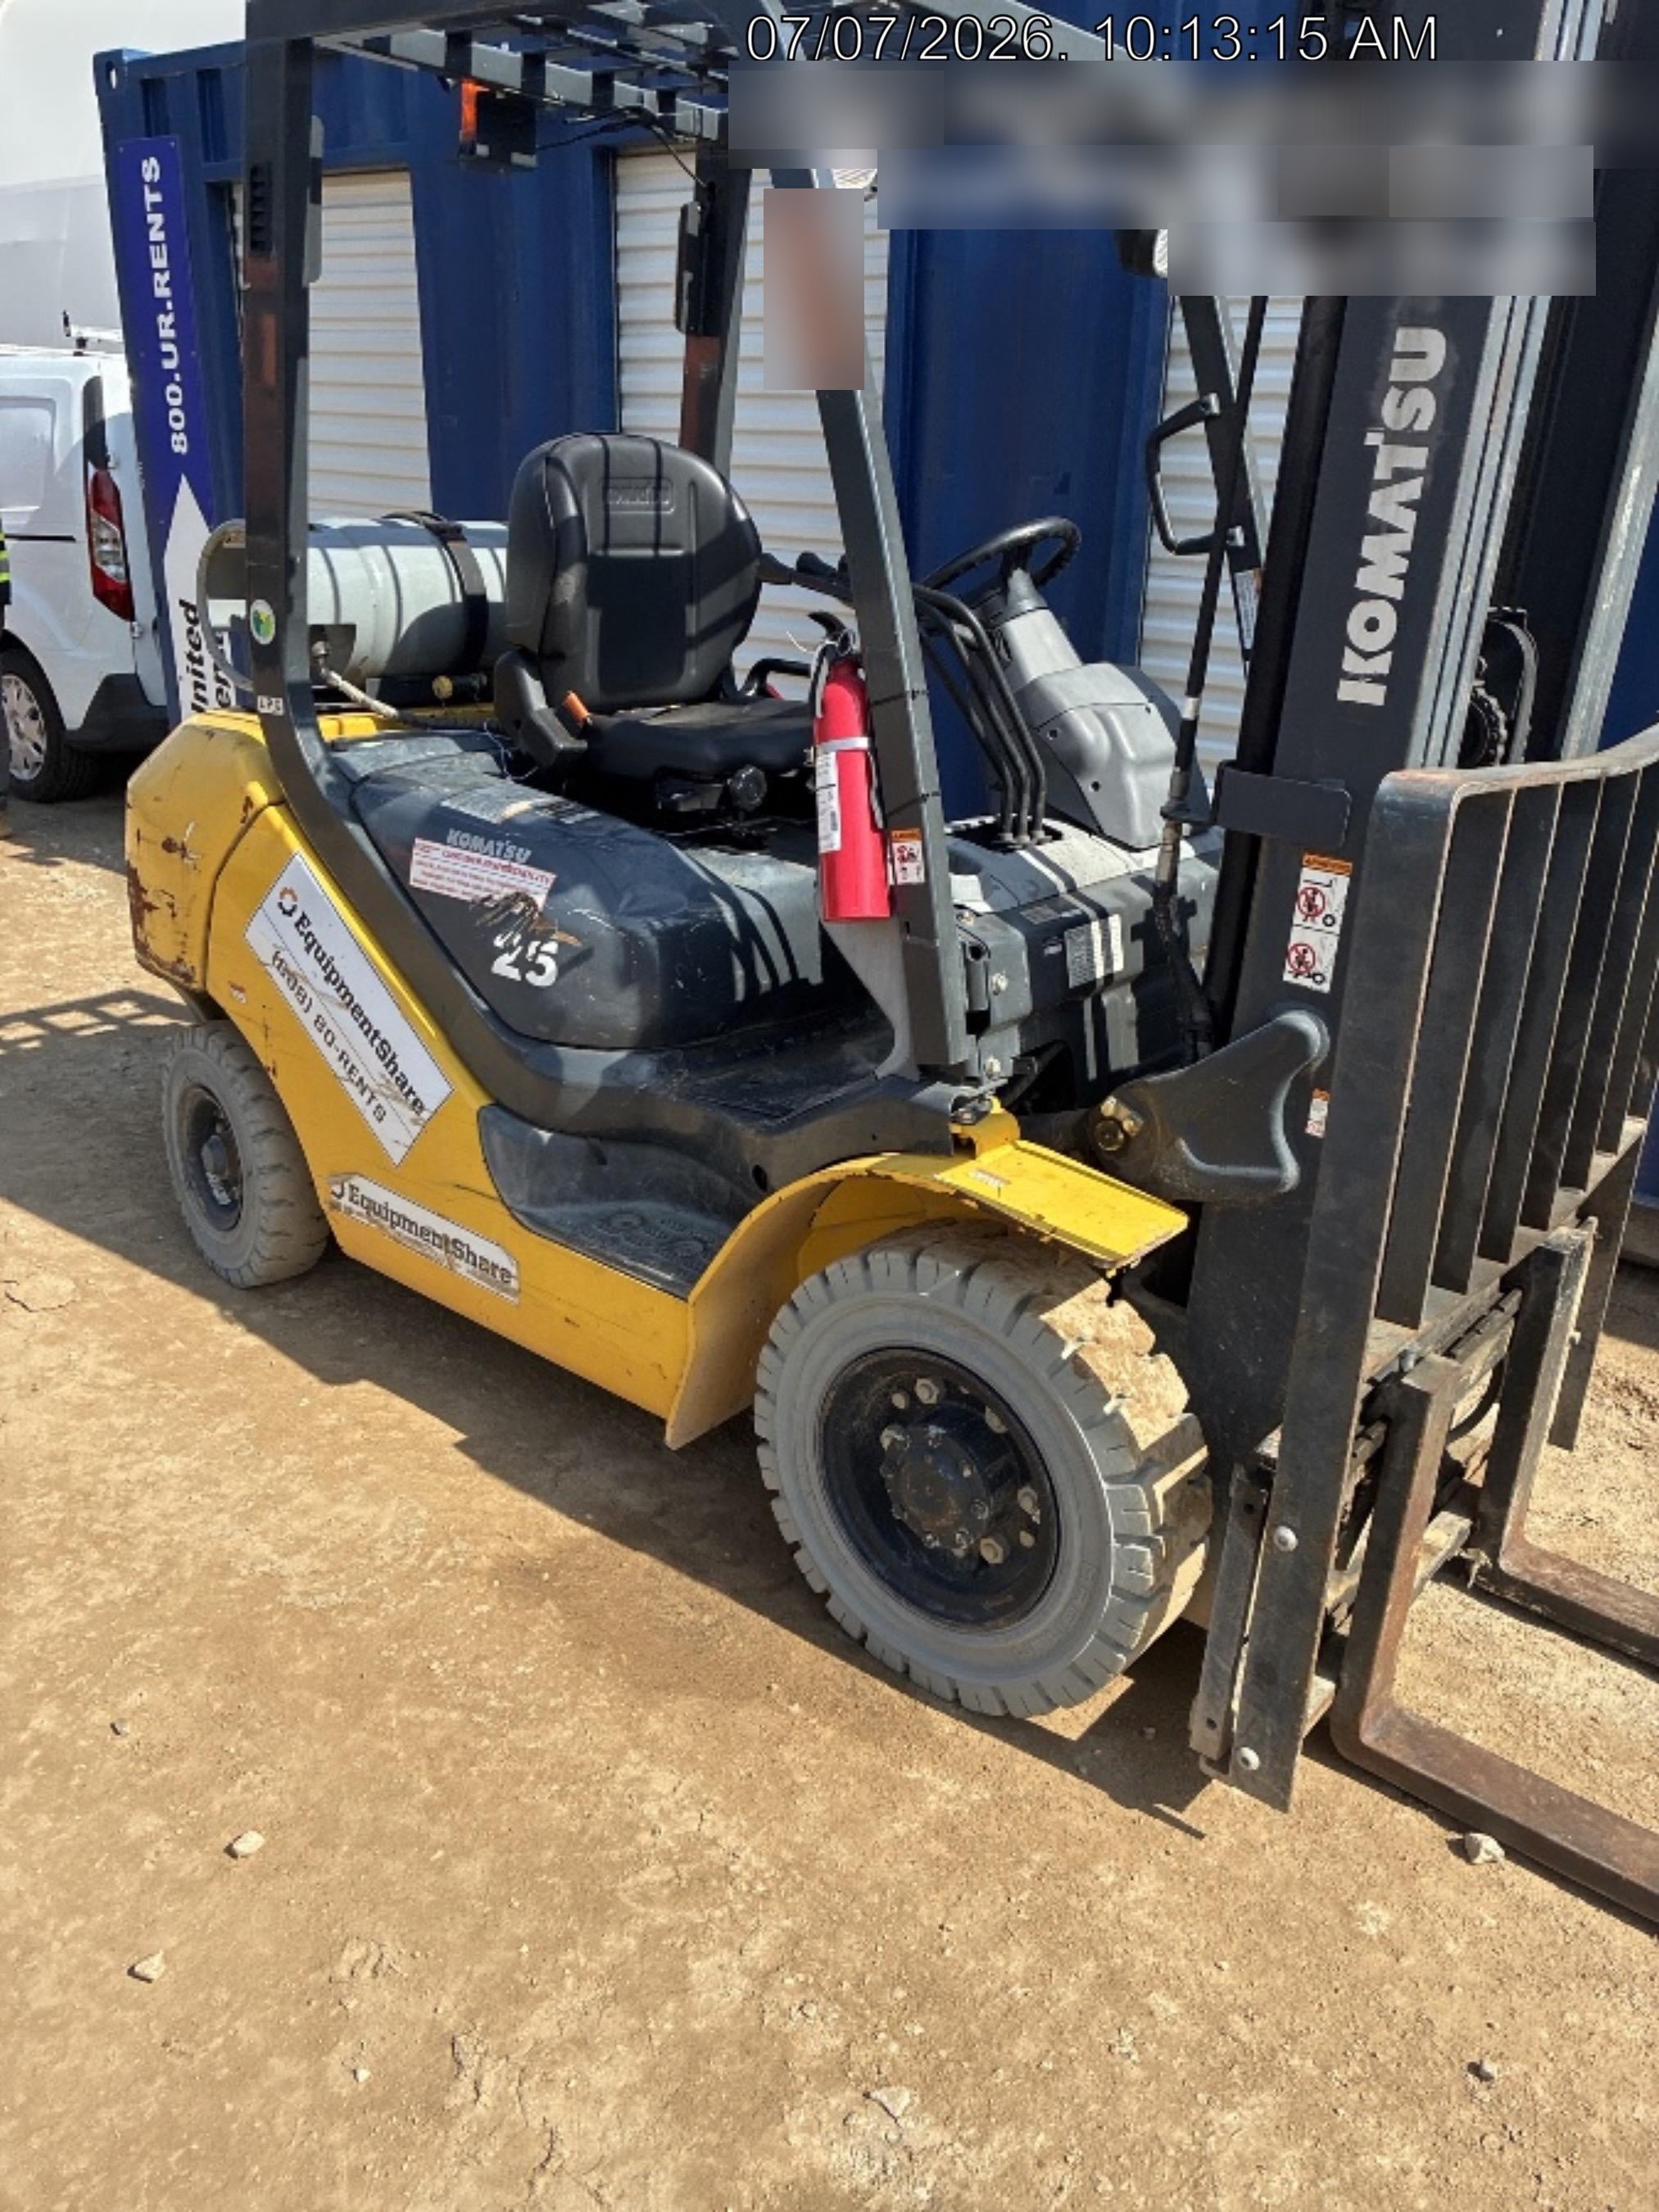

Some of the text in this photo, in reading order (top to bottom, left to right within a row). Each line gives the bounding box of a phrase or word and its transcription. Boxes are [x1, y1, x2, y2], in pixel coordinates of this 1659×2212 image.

[142, 156, 188, 455] 800.UR.RENTS
[1336, 327, 1447, 706] KOMATSU
[446, 828, 531, 864] KOMATSU
[293, 911, 426, 1116] EquipmentShare
[491, 931, 558, 986] 25
